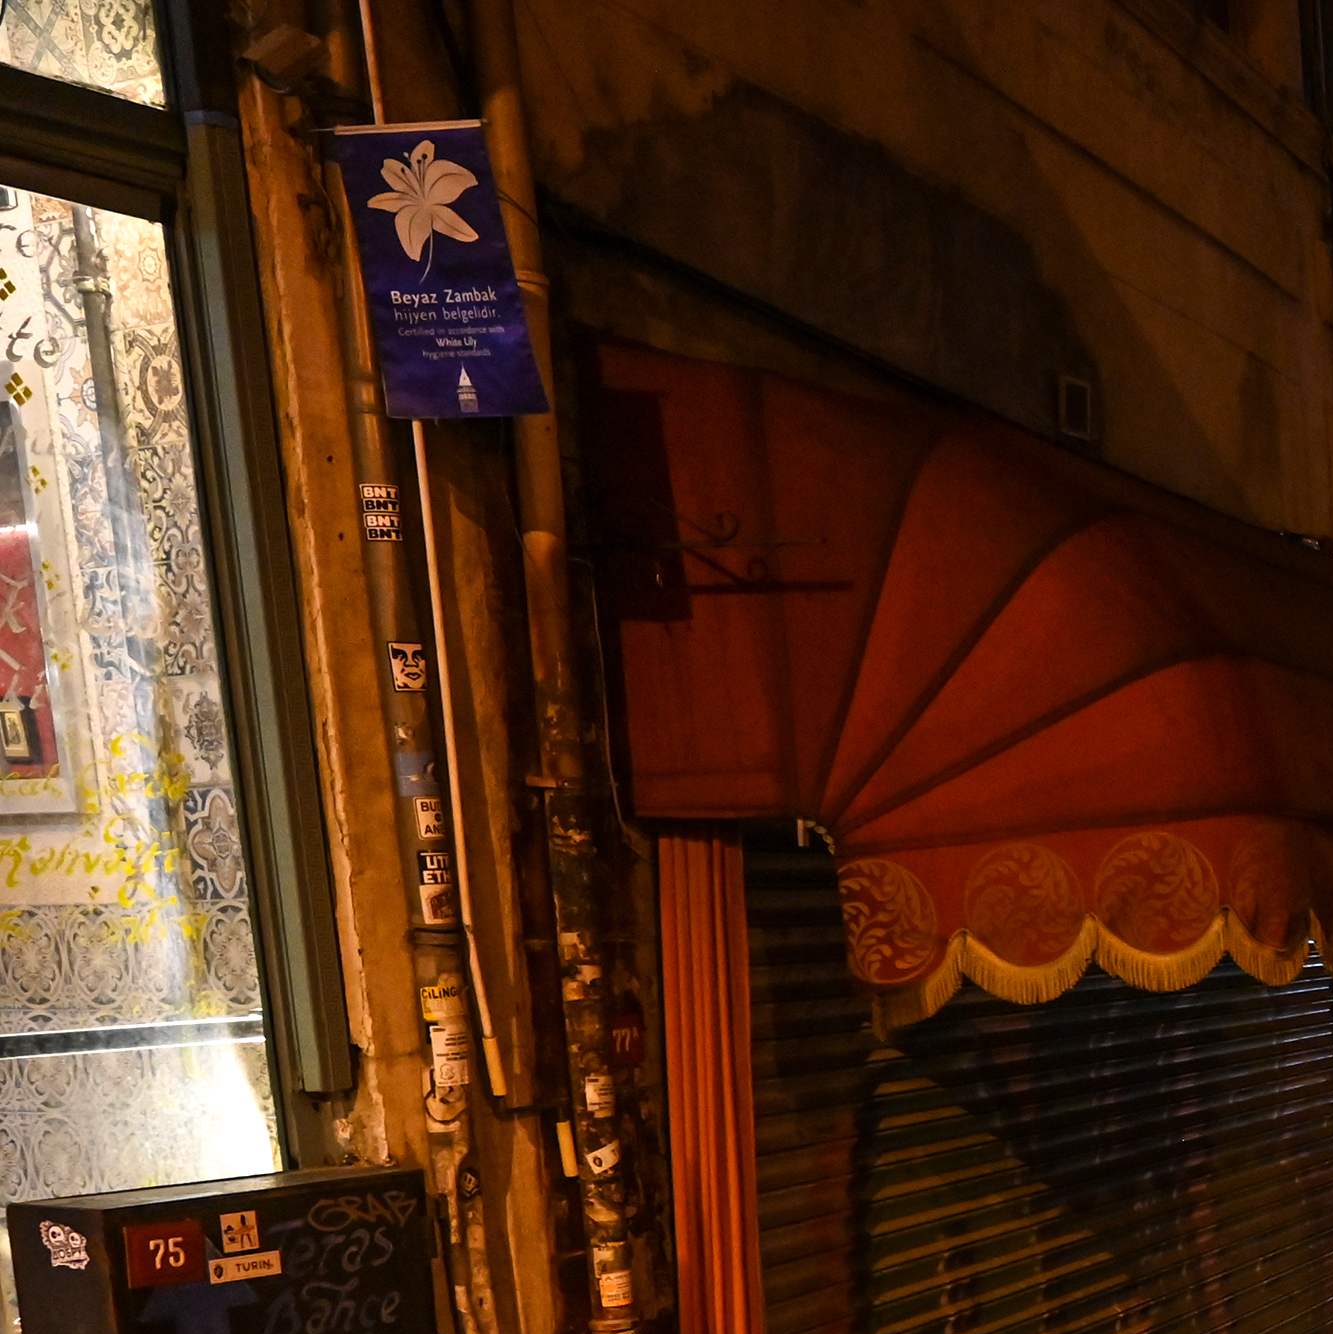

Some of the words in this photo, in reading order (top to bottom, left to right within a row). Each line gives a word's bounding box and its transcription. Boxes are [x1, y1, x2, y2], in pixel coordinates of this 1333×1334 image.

[391, 290, 438, 308] Beyaz
[444, 285, 497, 304] Zambak
[394, 308, 437, 324] hijyen
[488, 326, 505, 334] with
[436, 337, 462, 348] White
[464, 338, 477, 351] Lily
[363, 486, 397, 498] BNT
[364, 500, 399, 510] BNT
[366, 515, 400, 527] BNT
[368, 528, 401, 539] BNT
[149, 1236, 186, 1270] 75
